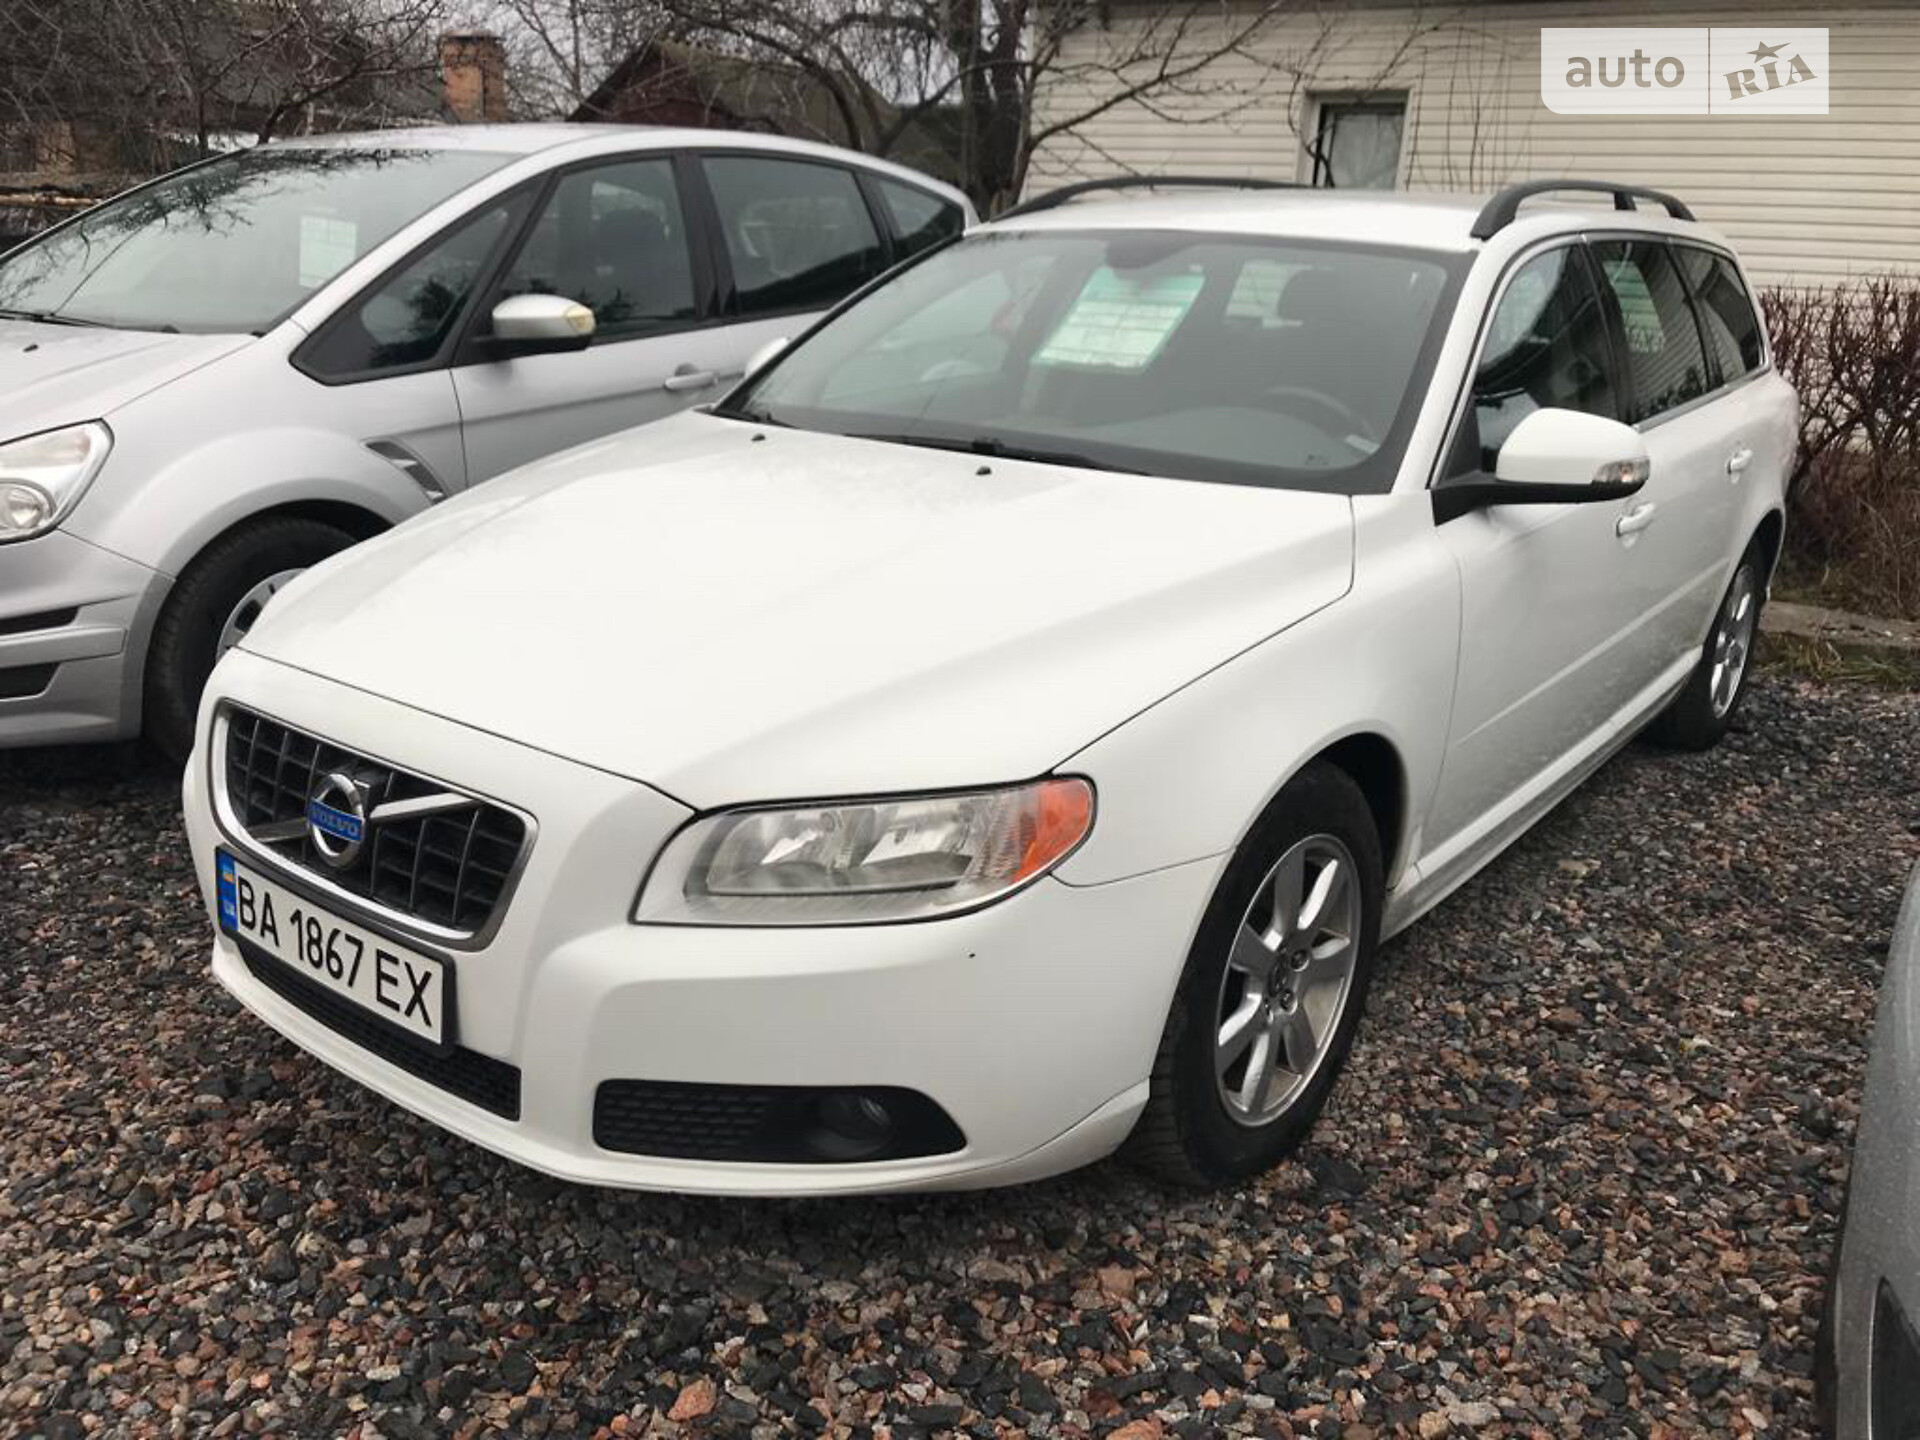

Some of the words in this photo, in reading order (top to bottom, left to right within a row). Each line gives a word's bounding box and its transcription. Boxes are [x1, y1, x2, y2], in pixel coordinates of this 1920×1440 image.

[238, 876, 280, 948] BA
[290, 909, 364, 988] 1867
[376, 948, 432, 1027] EX
